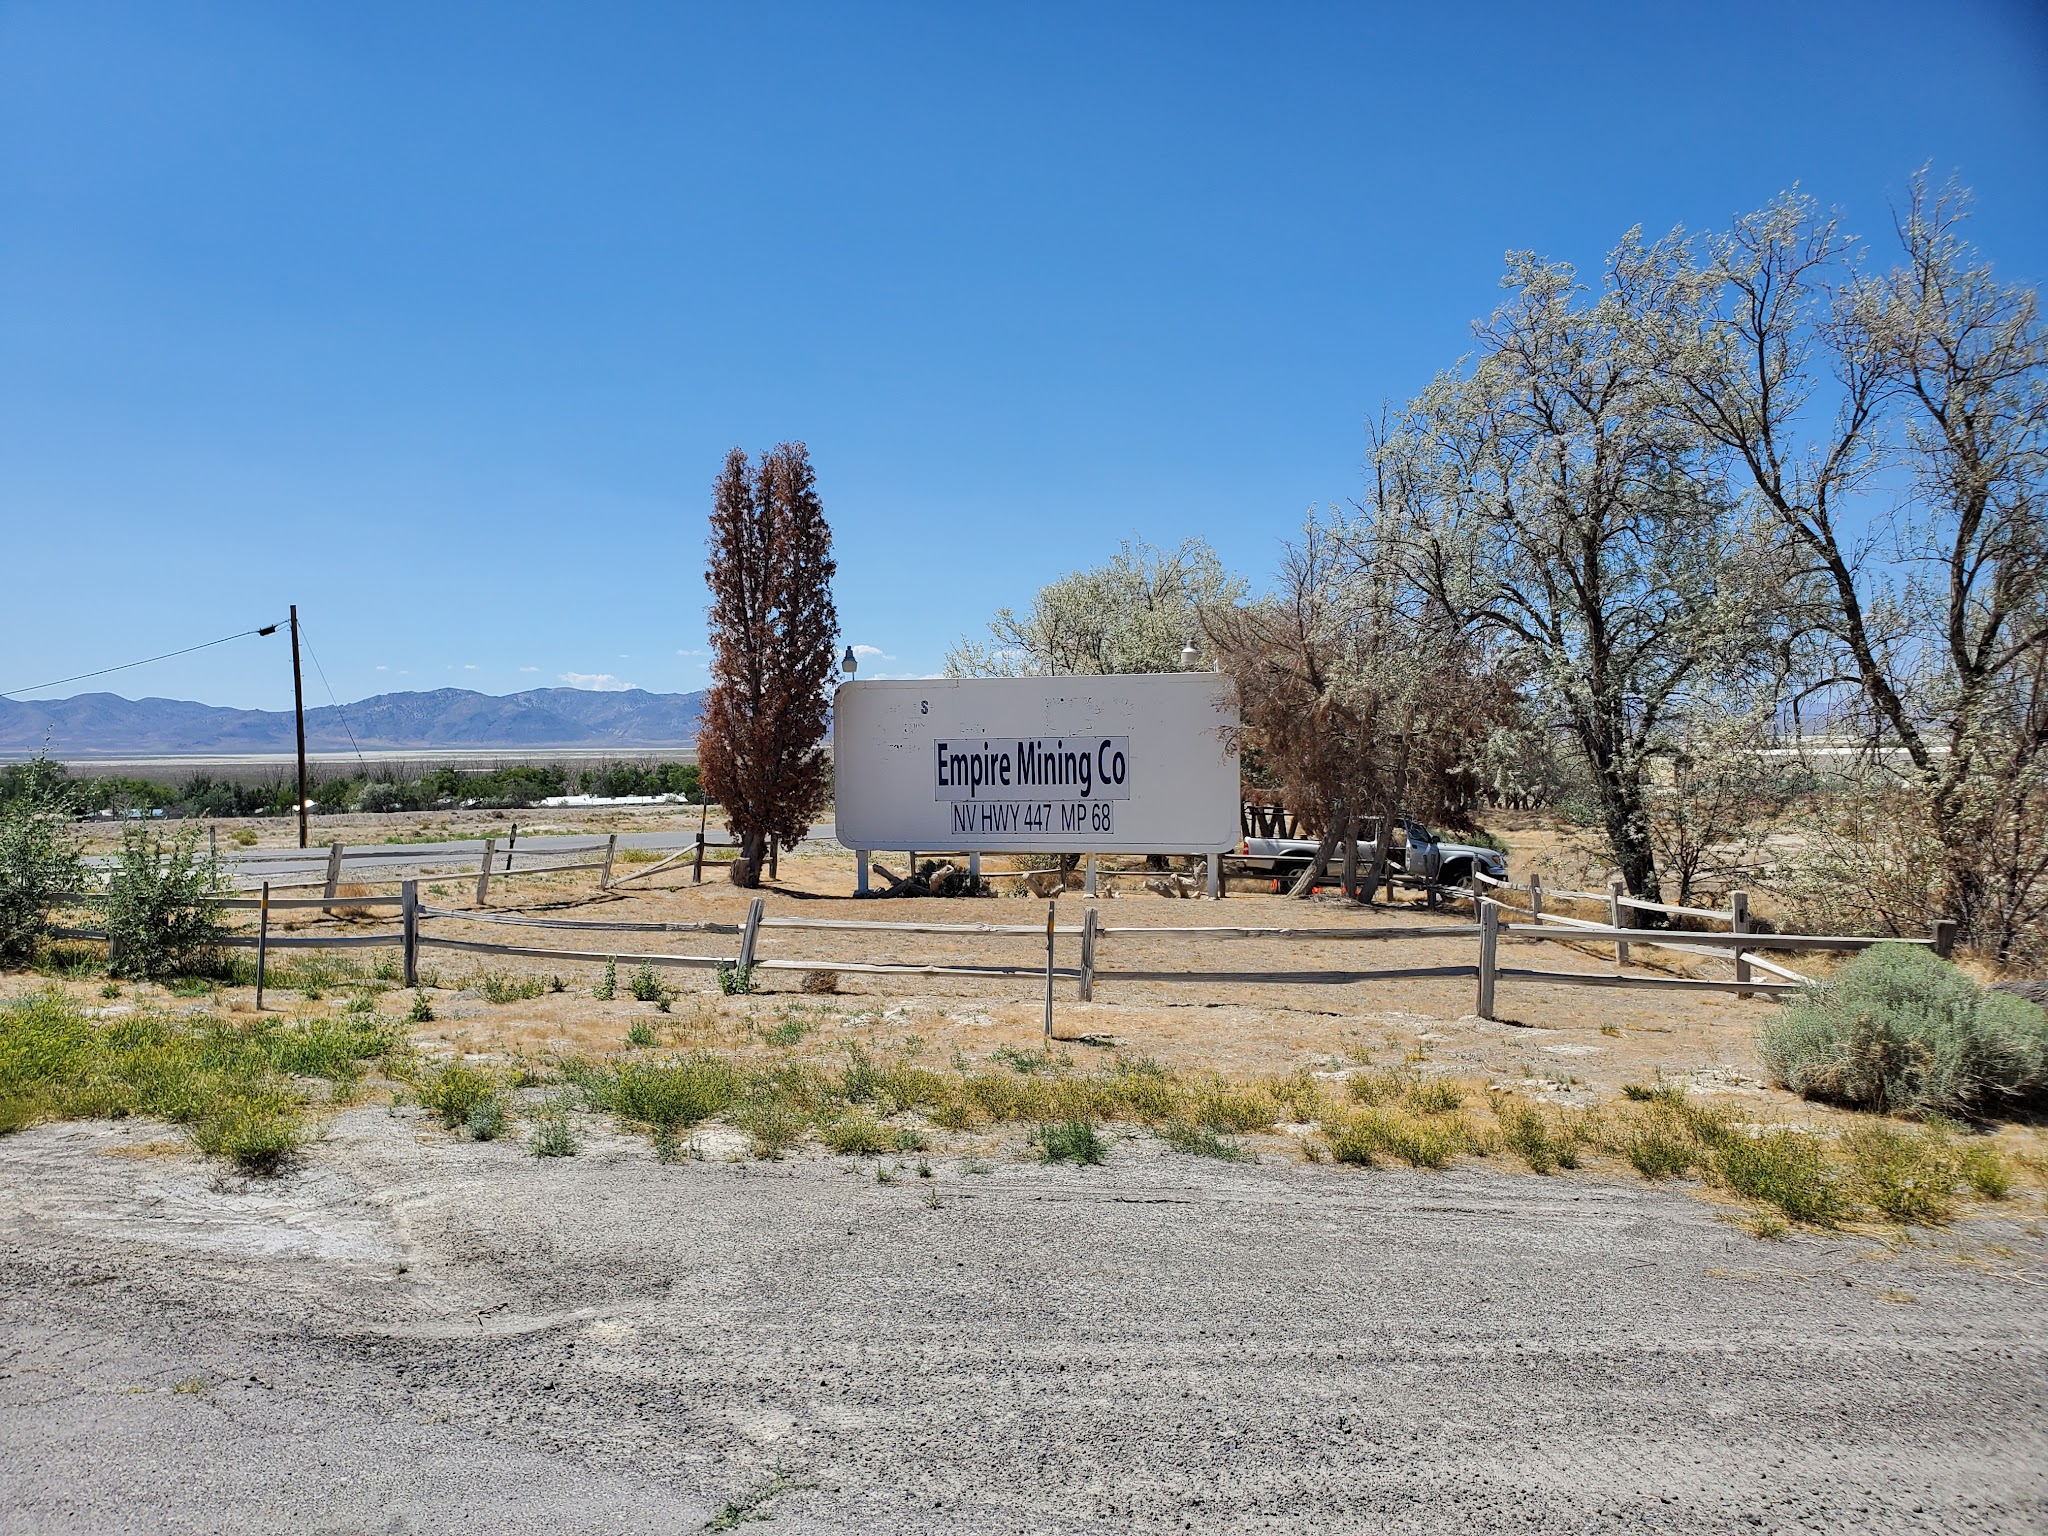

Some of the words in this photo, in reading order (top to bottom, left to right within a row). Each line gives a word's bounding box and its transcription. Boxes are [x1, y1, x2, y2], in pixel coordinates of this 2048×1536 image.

[938, 742, 1011, 798] Empire
[1017, 740, 1091, 798] Mining
[1098, 739, 1126, 785] Co
[953, 804, 976, 832] NV
[982, 803, 1019, 832] HWY
[1024, 803, 1052, 831] 447
[1061, 803, 1087, 831] MP
[1091, 803, 1111, 831] 68
